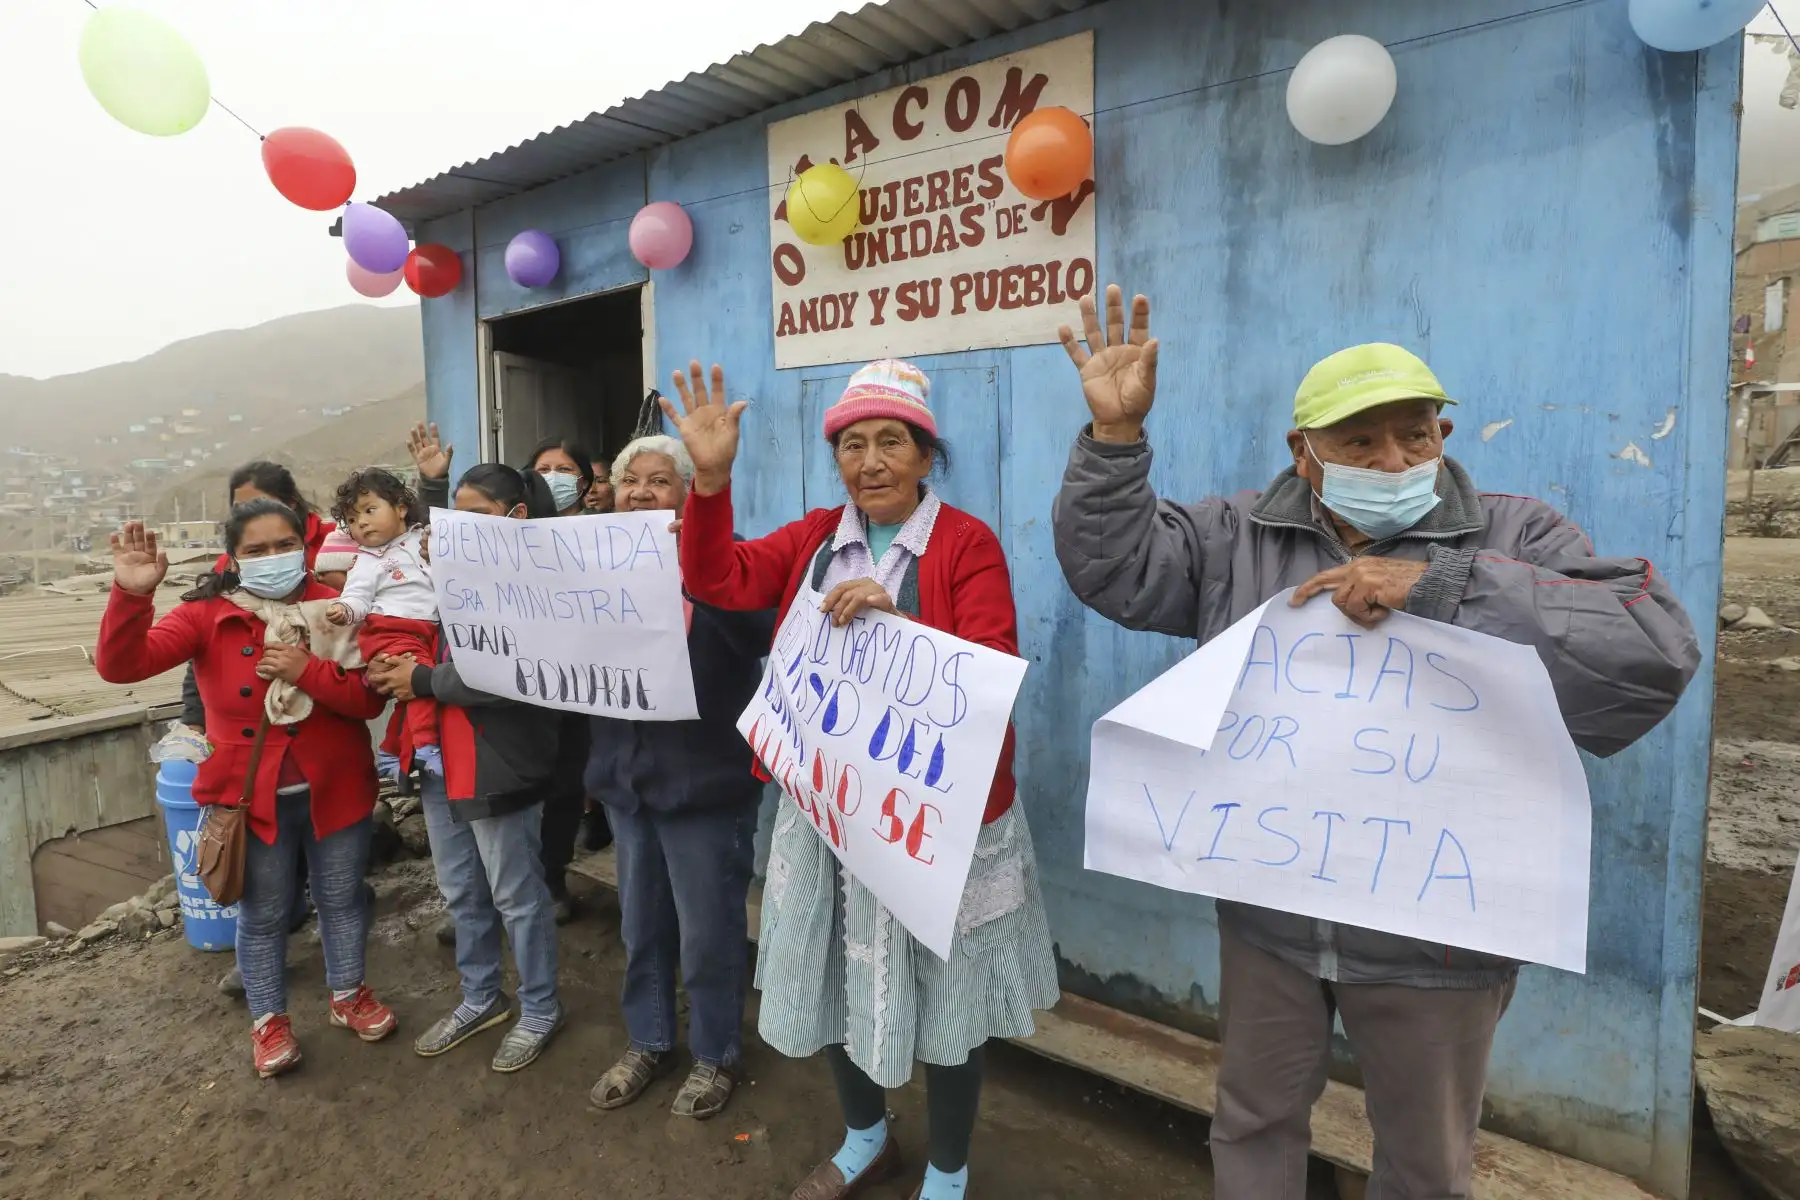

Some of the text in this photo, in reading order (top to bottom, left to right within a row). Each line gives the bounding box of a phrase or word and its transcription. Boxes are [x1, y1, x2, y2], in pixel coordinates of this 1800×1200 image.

[854, 154, 1004, 229] UJERES
[995, 203, 1028, 240] DE
[867, 286, 890, 326] Y
[895, 277, 943, 322] SU
[950, 257, 1094, 316] PUEBLO
[436, 518, 663, 572] BIENVENIDA
[495, 581, 644, 625] MINISTRA
[515, 657, 657, 711] BOLUARTE
[1238, 625, 1480, 712] ACIAS
[868, 705, 954, 793] DEL
[1351, 728, 1440, 783] SU
[872, 788, 943, 866] SE
[1143, 783, 1477, 912] VISITA
